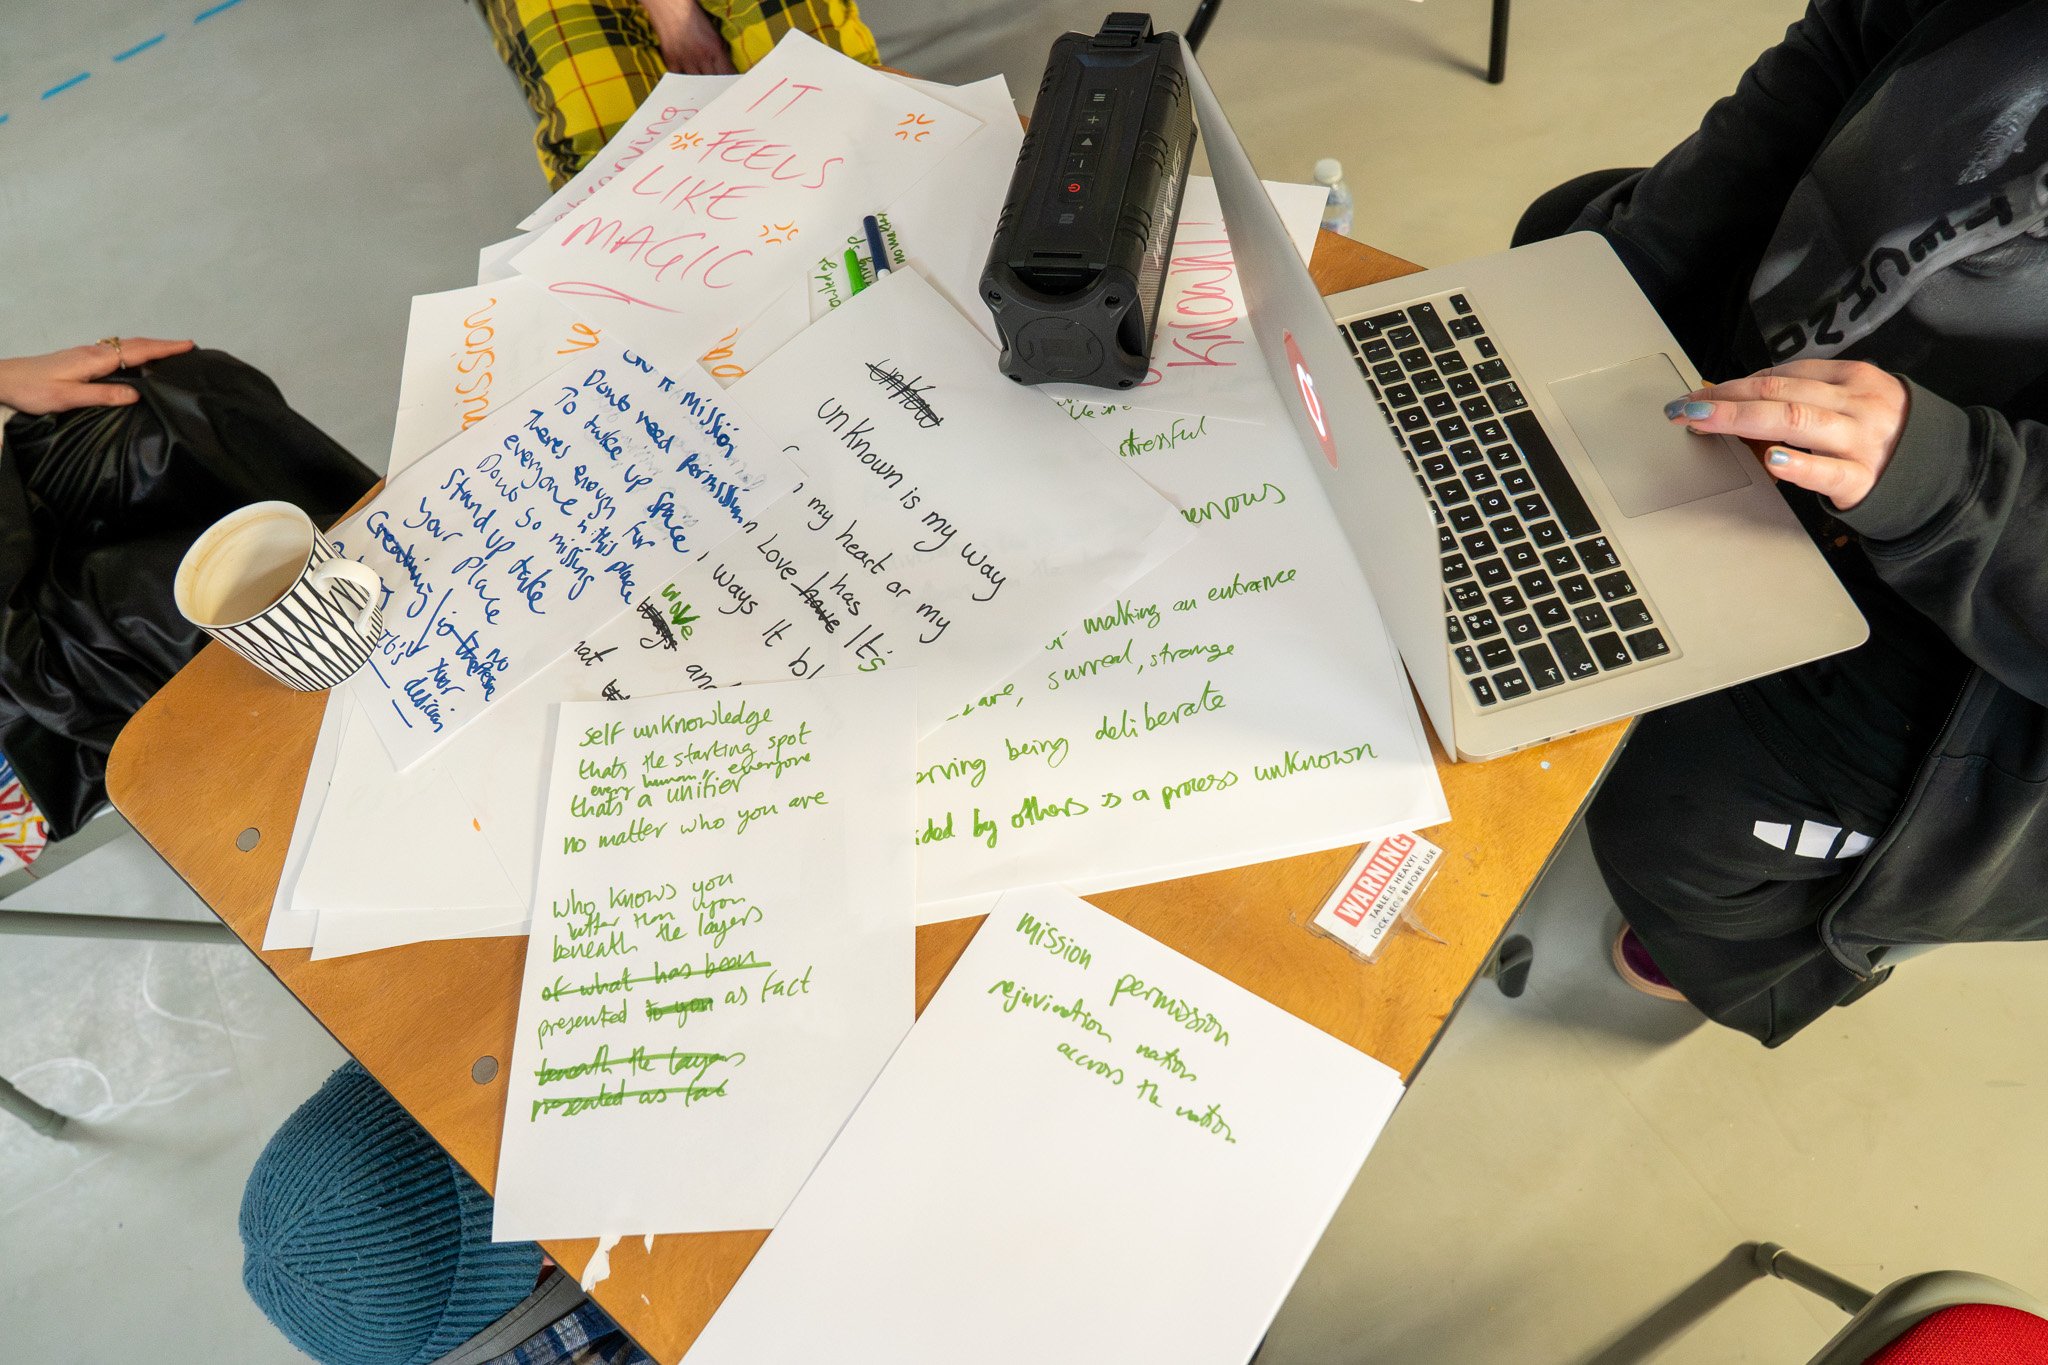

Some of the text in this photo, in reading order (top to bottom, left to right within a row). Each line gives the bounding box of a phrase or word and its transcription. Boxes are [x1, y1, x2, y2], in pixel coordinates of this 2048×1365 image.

[746, 77, 822, 118] IT
[699, 129, 844, 190] FEELS
[632, 164, 767, 221] LIKE
[561, 216, 753, 289] MAGIC
[1118, 415, 1207, 458] stressful
[806, 495, 834, 531] my
[835, 519, 893, 576] heart
[886, 580, 911, 598] or
[915, 601, 951, 644] my
[899, 487, 921, 509] is
[913, 511, 957, 552] my
[961, 542, 1007, 602] way
[1207, 567, 1297, 603] entrance
[579, 721, 625, 748] self
[674, 740, 757, 768] starting
[767, 721, 813, 763] spot
[1005, 737, 1069, 769] being
[1094, 680, 1227, 742] deliberate
[599, 817, 668, 848] matter
[680, 813, 726, 835] who
[737, 804, 779, 835] you
[788, 790, 829, 809] are
[973, 808, 998, 849] by
[1161, 770, 1239, 810] process
[1337, 833, 1412, 921] WARNING
[1369, 854, 1419, 919] TABLE IS HEAVY!
[1371, 916, 1390, 940] LOCK
[1401, 865, 1425, 896] BEFORE
[1423, 848, 1437, 866] USE
[698, 905, 764, 949] layers
[538, 998, 629, 1049] presented
[725, 985, 748, 1006] as
[761, 966, 814, 1003] fact
[1108, 973, 1230, 1047] permission
